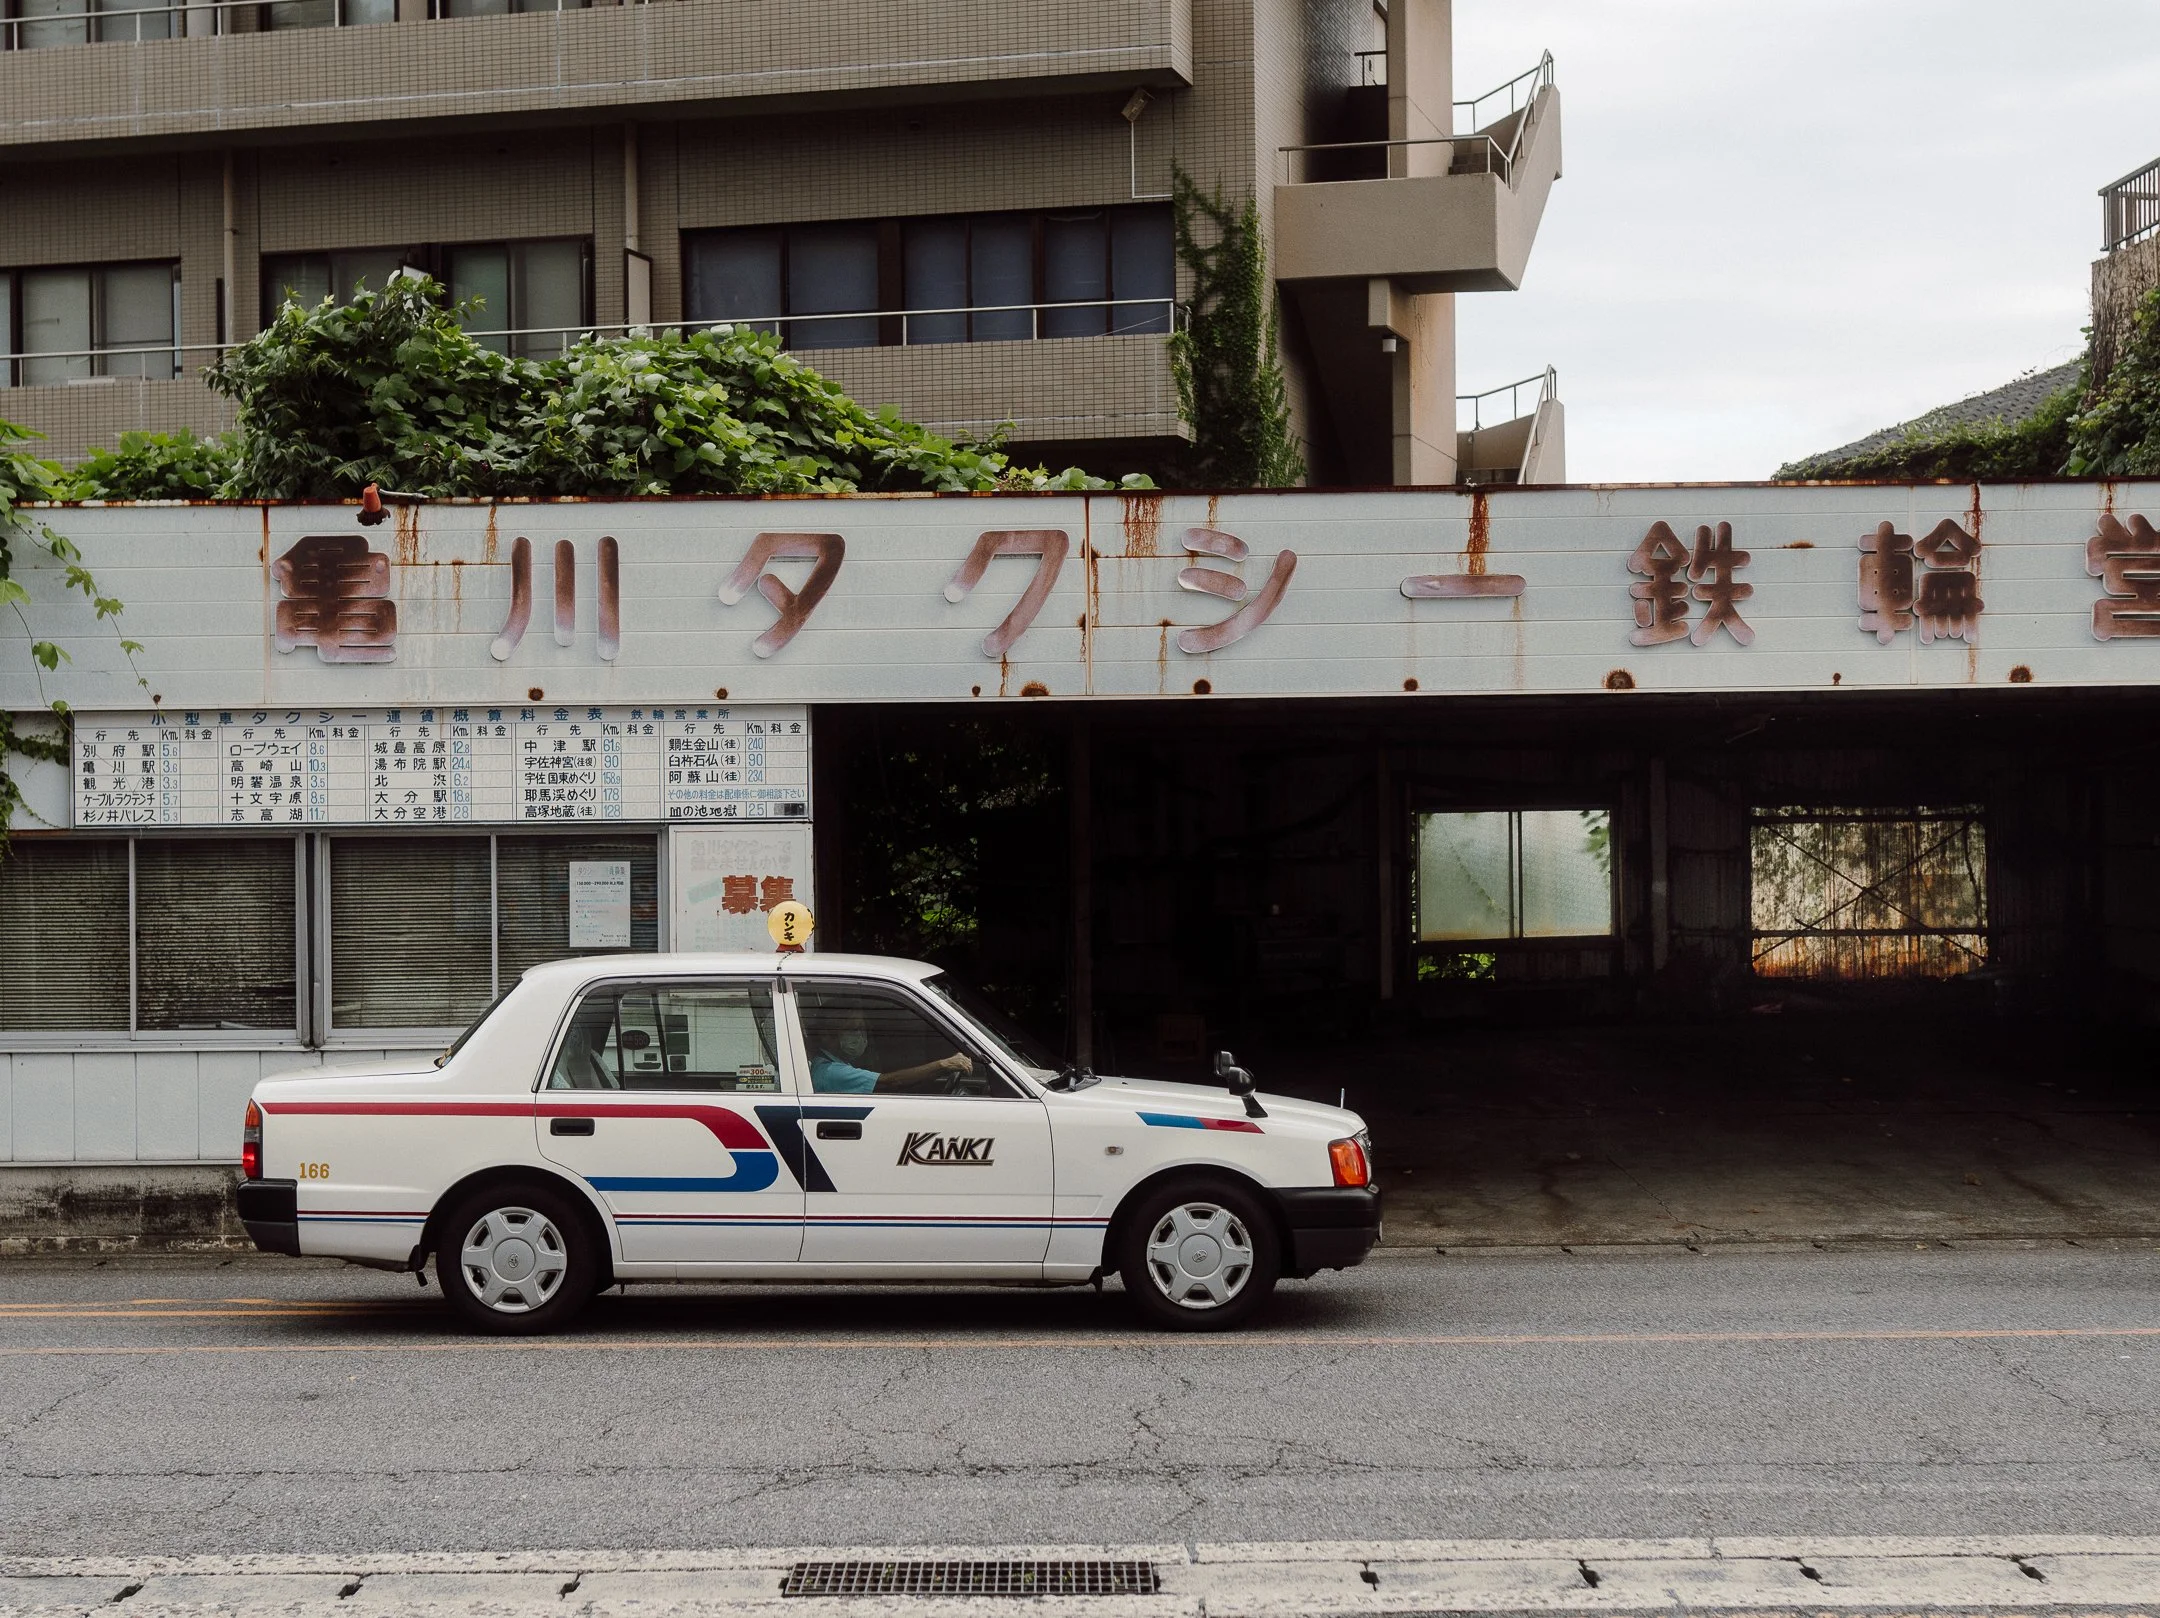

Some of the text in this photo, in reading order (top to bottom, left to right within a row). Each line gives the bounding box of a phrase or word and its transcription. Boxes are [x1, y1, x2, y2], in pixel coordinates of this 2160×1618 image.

[243, 728, 286, 739] 行先
[333, 728, 359, 738] 料金
[390, 726, 430, 737] 行先
[477, 725, 506, 736] 料金
[537, 724, 581, 736] 行先
[627, 724, 654, 735] 料金
[685, 723, 724, 734] 行先
[771, 722, 801, 734] 料金
[96, 730, 139, 741] 行先
[185, 729, 212, 740] 料金
[310, 742, 325, 755] 8.6
[374, 741, 446, 754] 城島高原
[452, 741, 470, 753] 12.8
[525, 739, 596, 752] 中津駅
[748, 738, 764, 750] 240
[83, 744, 156, 758] 別府駅
[162, 744, 178, 757] 5.6
[231, 759, 302, 772] 高崎山
[309, 759, 326, 772] 10.3
[374, 758, 446, 770] 湯布院駅
[452, 757, 470, 770] 24.4
[604, 755, 619, 768] 90
[748, 754, 763, 766] 90
[83, 760, 156, 774] 亀川駅
[162, 760, 178, 773] 3.6
[310, 776, 326, 788] 3.5
[374, 774, 446, 786] 北浜
[454, 774, 468, 786] 6.2
[524, 772, 596, 785] 宇佐国東めぐり
[748, 770, 763, 782] 234
[83, 777, 156, 790] 観光港
[162, 777, 178, 790] 3.3
[83, 793, 156, 806] ケーブルラクテンチ
[162, 793, 178, 806] 5.7
[231, 792, 302, 804] 十文字原
[310, 792, 325, 804] 8.5
[375, 790, 447, 804] 大分駅
[452, 790, 470, 802] 18.8
[603, 788, 620, 801] 178
[83, 810, 156, 822] 杉ノ井パレス
[162, 810, 178, 822] 5.3
[231, 808, 302, 821] 志高湖
[374, 806, 446, 820] 大分空港
[454, 806, 469, 819] 28
[604, 804, 620, 818] 128
[722, 875, 796, 914] 募集
[784, 912, 795, 941] カンキ
[300, 1162, 330, 1178] 166
